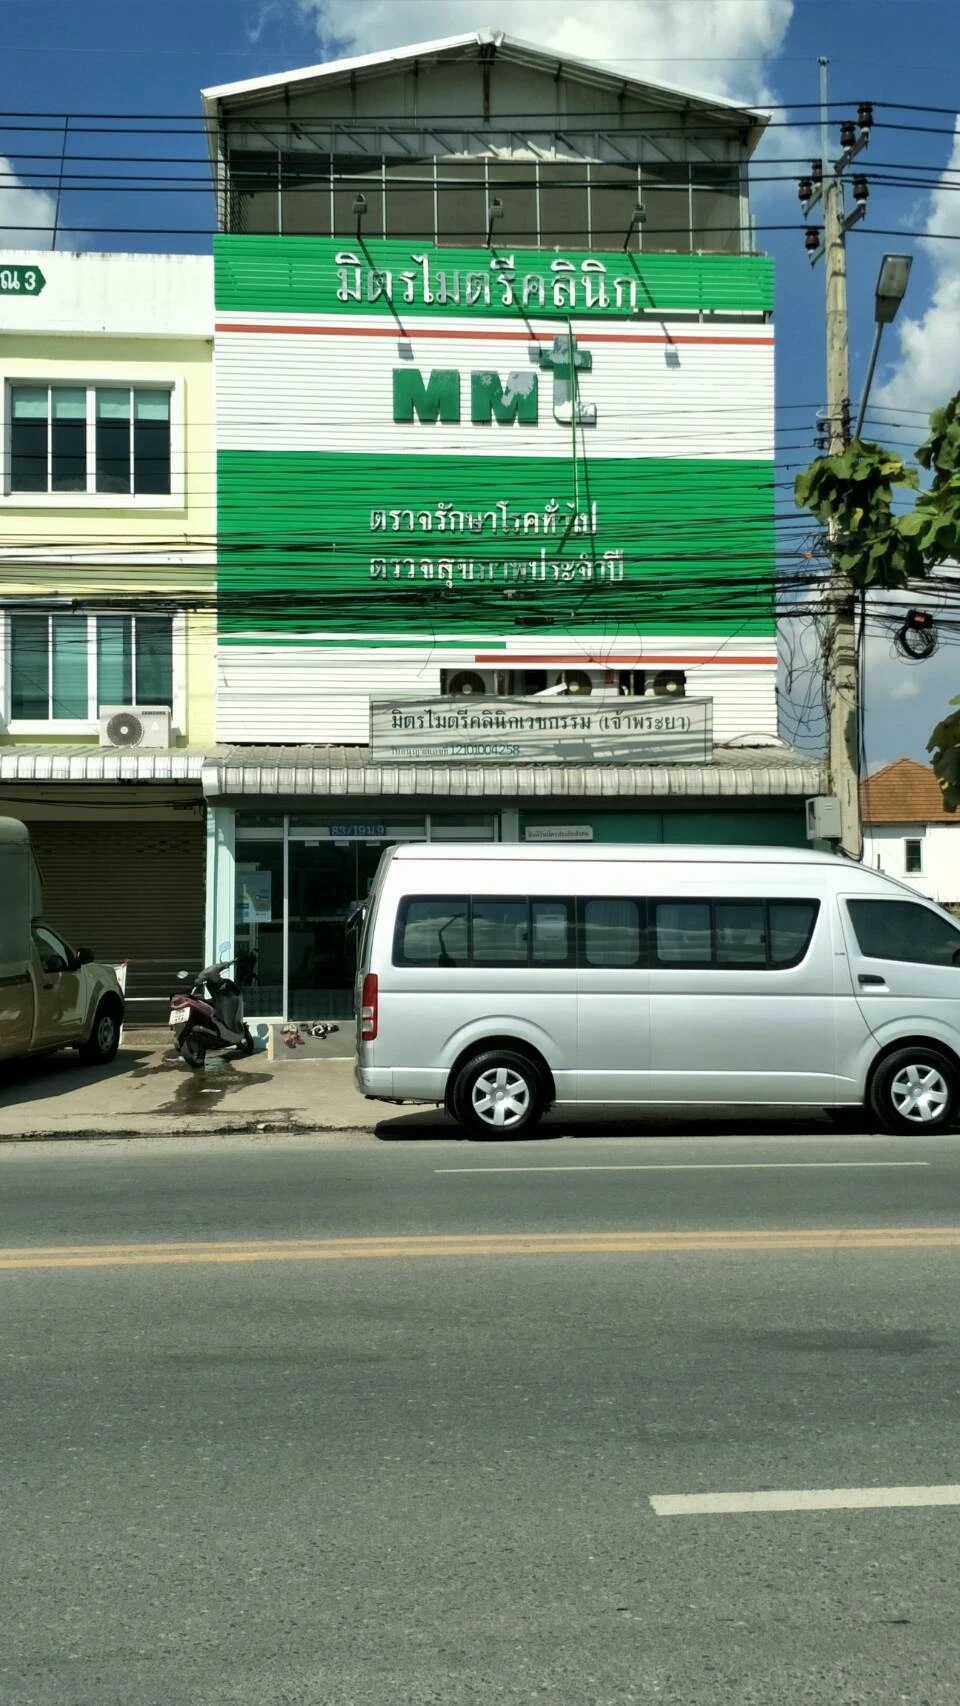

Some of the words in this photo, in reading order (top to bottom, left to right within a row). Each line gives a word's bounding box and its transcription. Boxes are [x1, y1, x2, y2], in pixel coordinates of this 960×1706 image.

[24, 271, 36, 290] 3
[334, 251, 637, 309] มิตรไมตรีคลินิก
[391, 709, 592, 730] มิตรไมตรีคลินิกเวชกรรม
[598, 709, 692, 732] (เจ้าพระยา)
[450, 744, 520, 756] 12101004258
